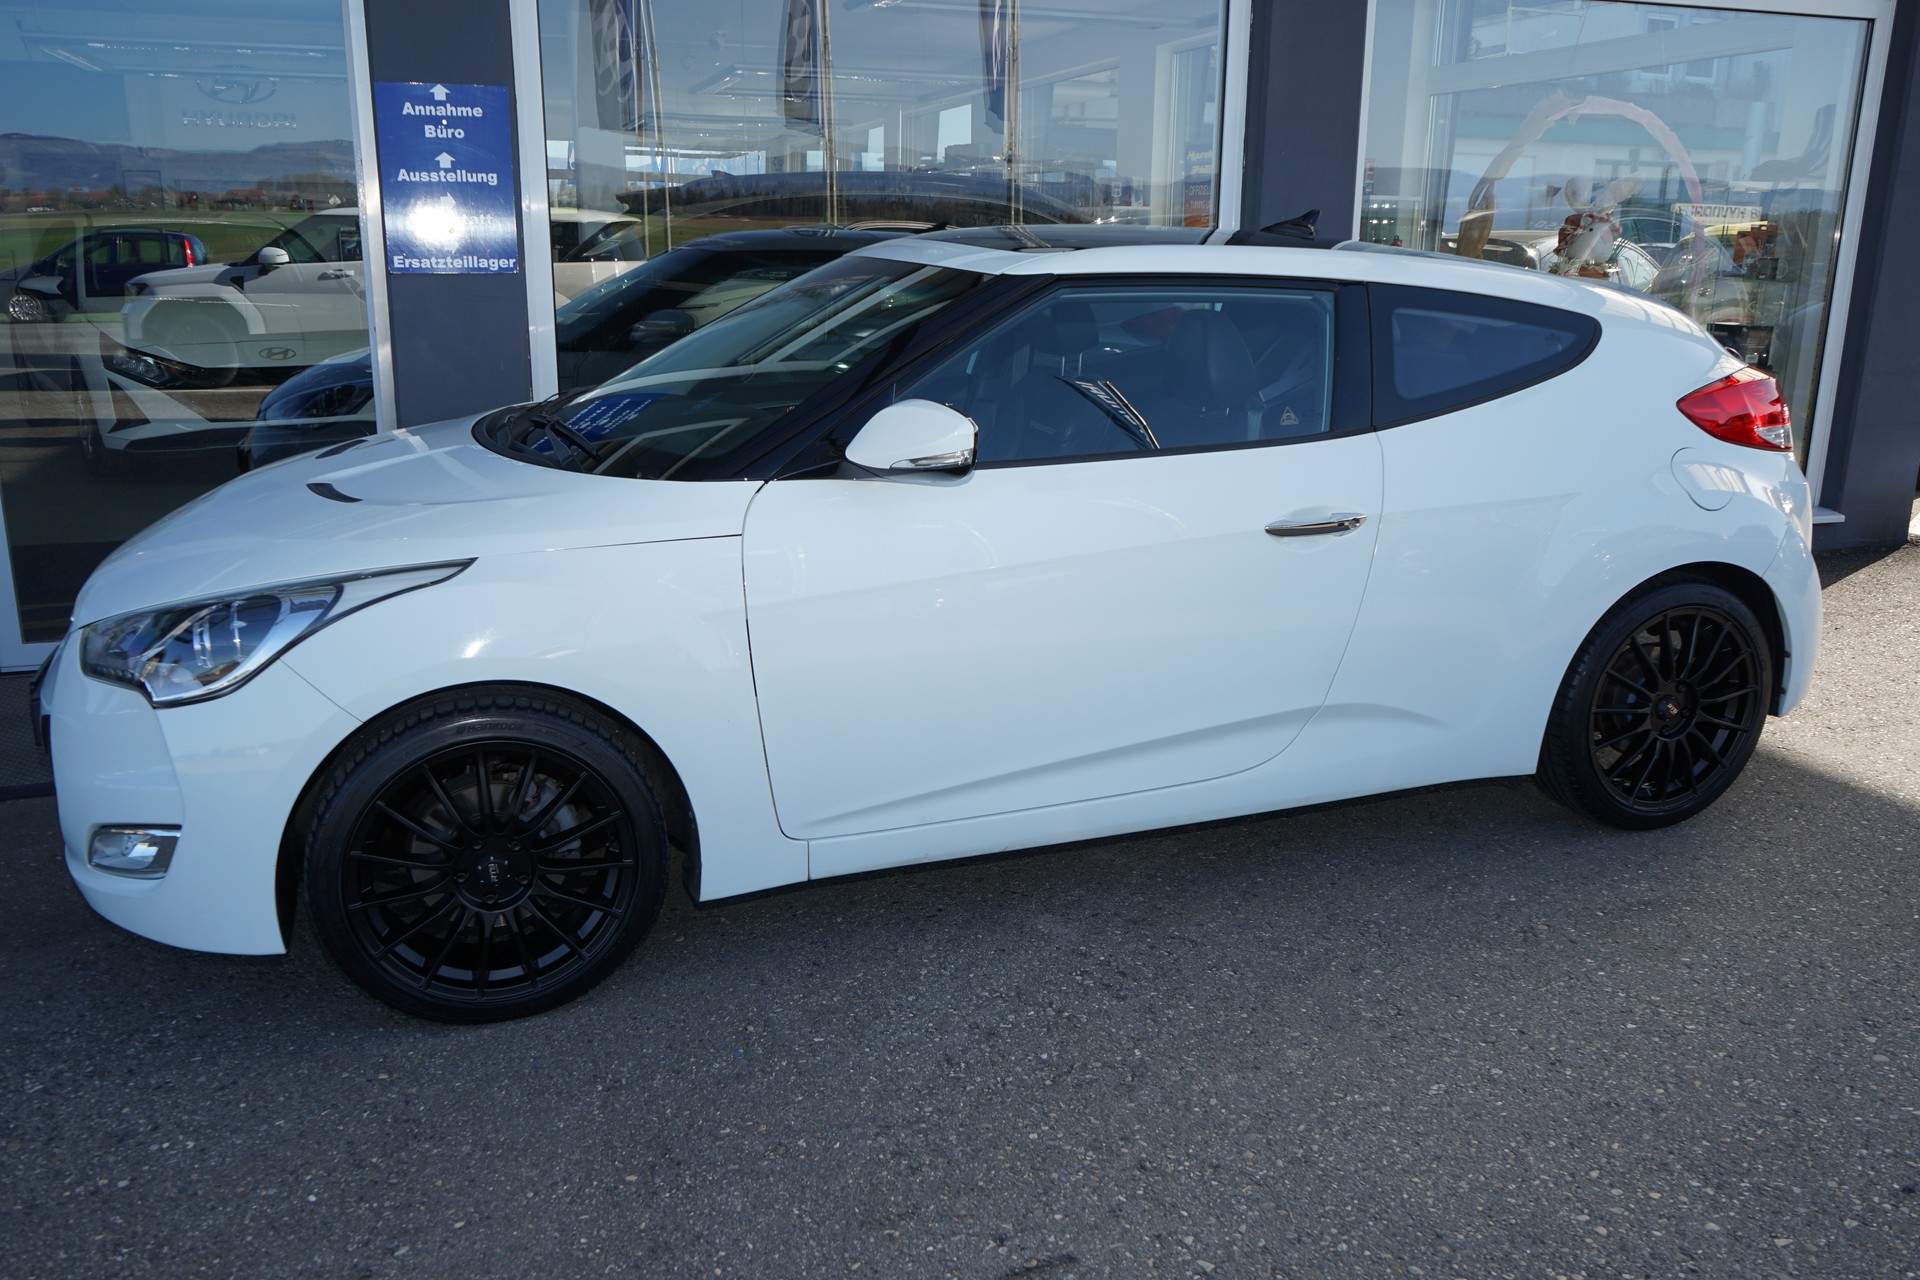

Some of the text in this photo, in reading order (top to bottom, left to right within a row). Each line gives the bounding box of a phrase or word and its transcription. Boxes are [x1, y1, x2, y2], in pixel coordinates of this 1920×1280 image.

[402, 102, 483, 117] Annahme
[424, 124, 465, 139] Büro
[397, 168, 498, 186] Ausstellung
[392, 255, 517, 271] Ersatzteillager
